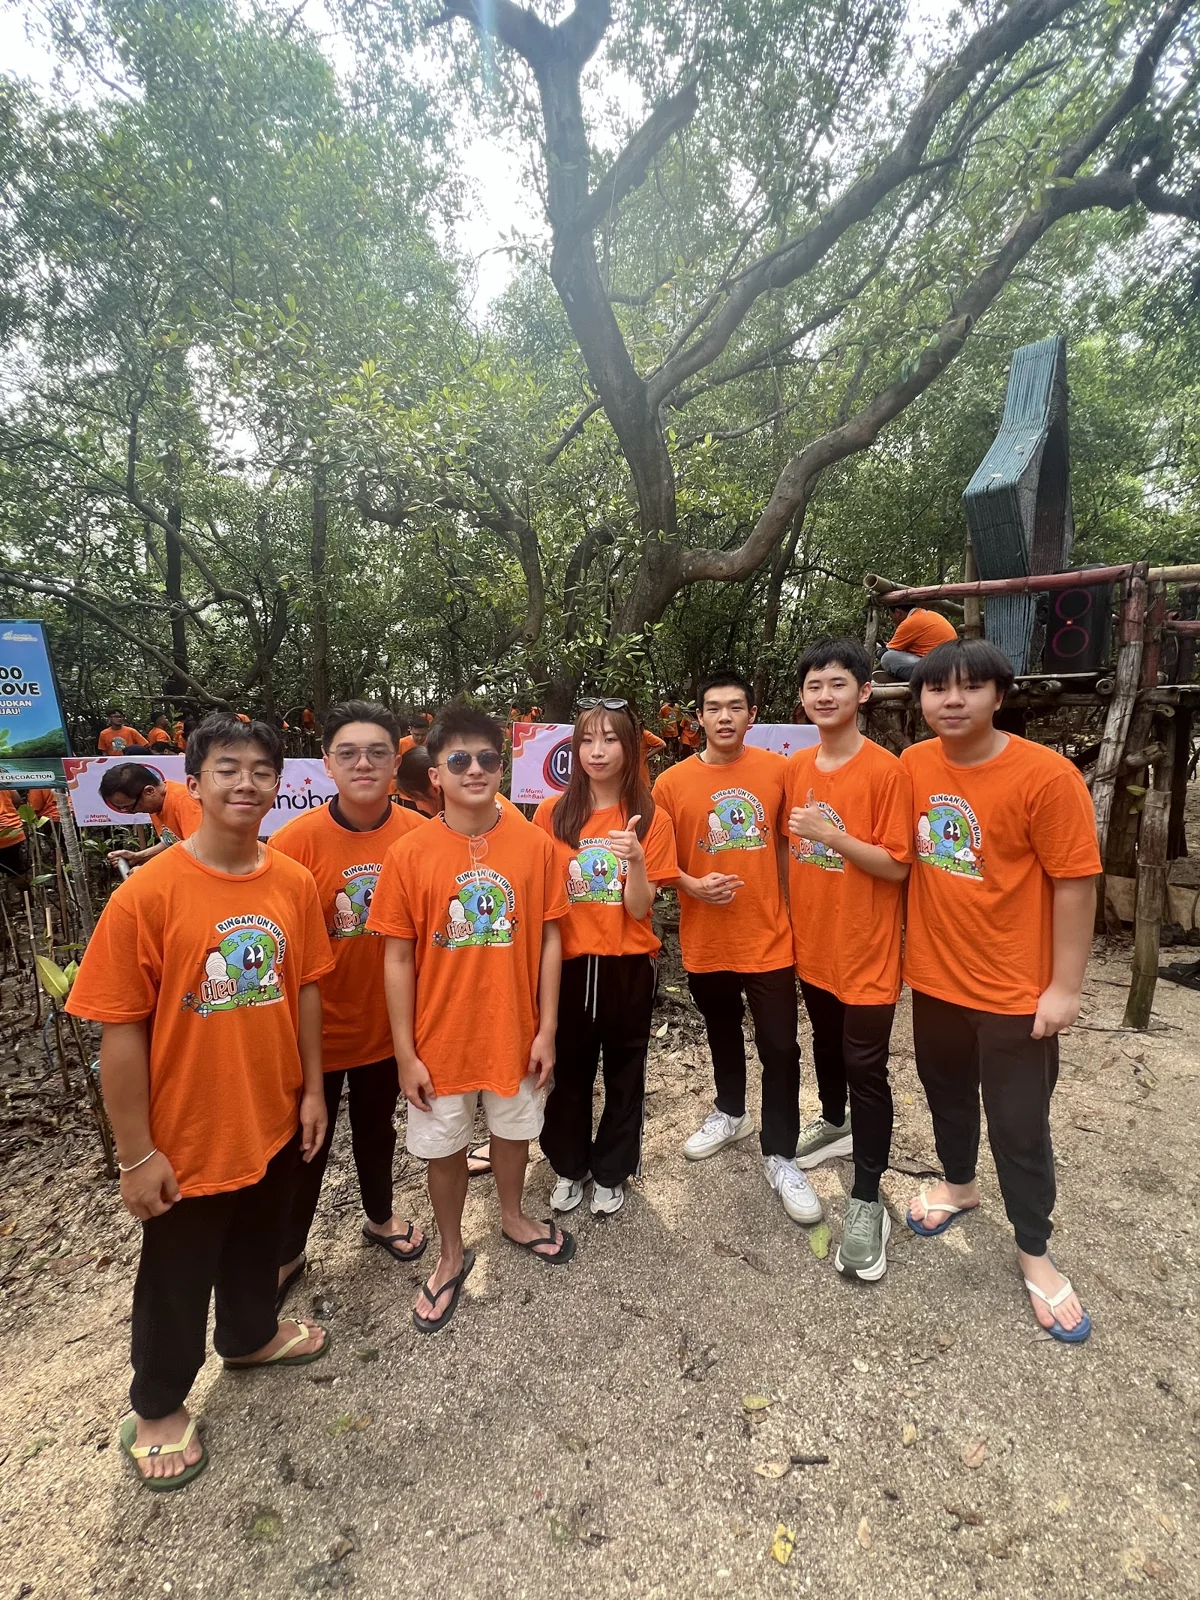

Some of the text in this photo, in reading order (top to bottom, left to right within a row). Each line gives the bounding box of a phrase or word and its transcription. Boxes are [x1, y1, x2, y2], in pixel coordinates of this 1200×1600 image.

[0, 682, 40, 695] OVE
[272, 789, 335, 809] nob
[711, 788, 764, 821] RINGAN UNTUK BUMI
[930, 794, 981, 848] RINGAN UNTUK BUMI
[707, 829, 730, 846] Cleo
[343, 864, 375, 877] RINGAN
[488, 871, 511, 891] UNTUK
[507, 889, 515, 912] BUMI
[566, 879, 591, 895] Cleo
[217, 915, 286, 963] RINGAN UNTUK BUMI
[446, 920, 475, 939] Cleo
[201, 978, 238, 1003] Cleo
